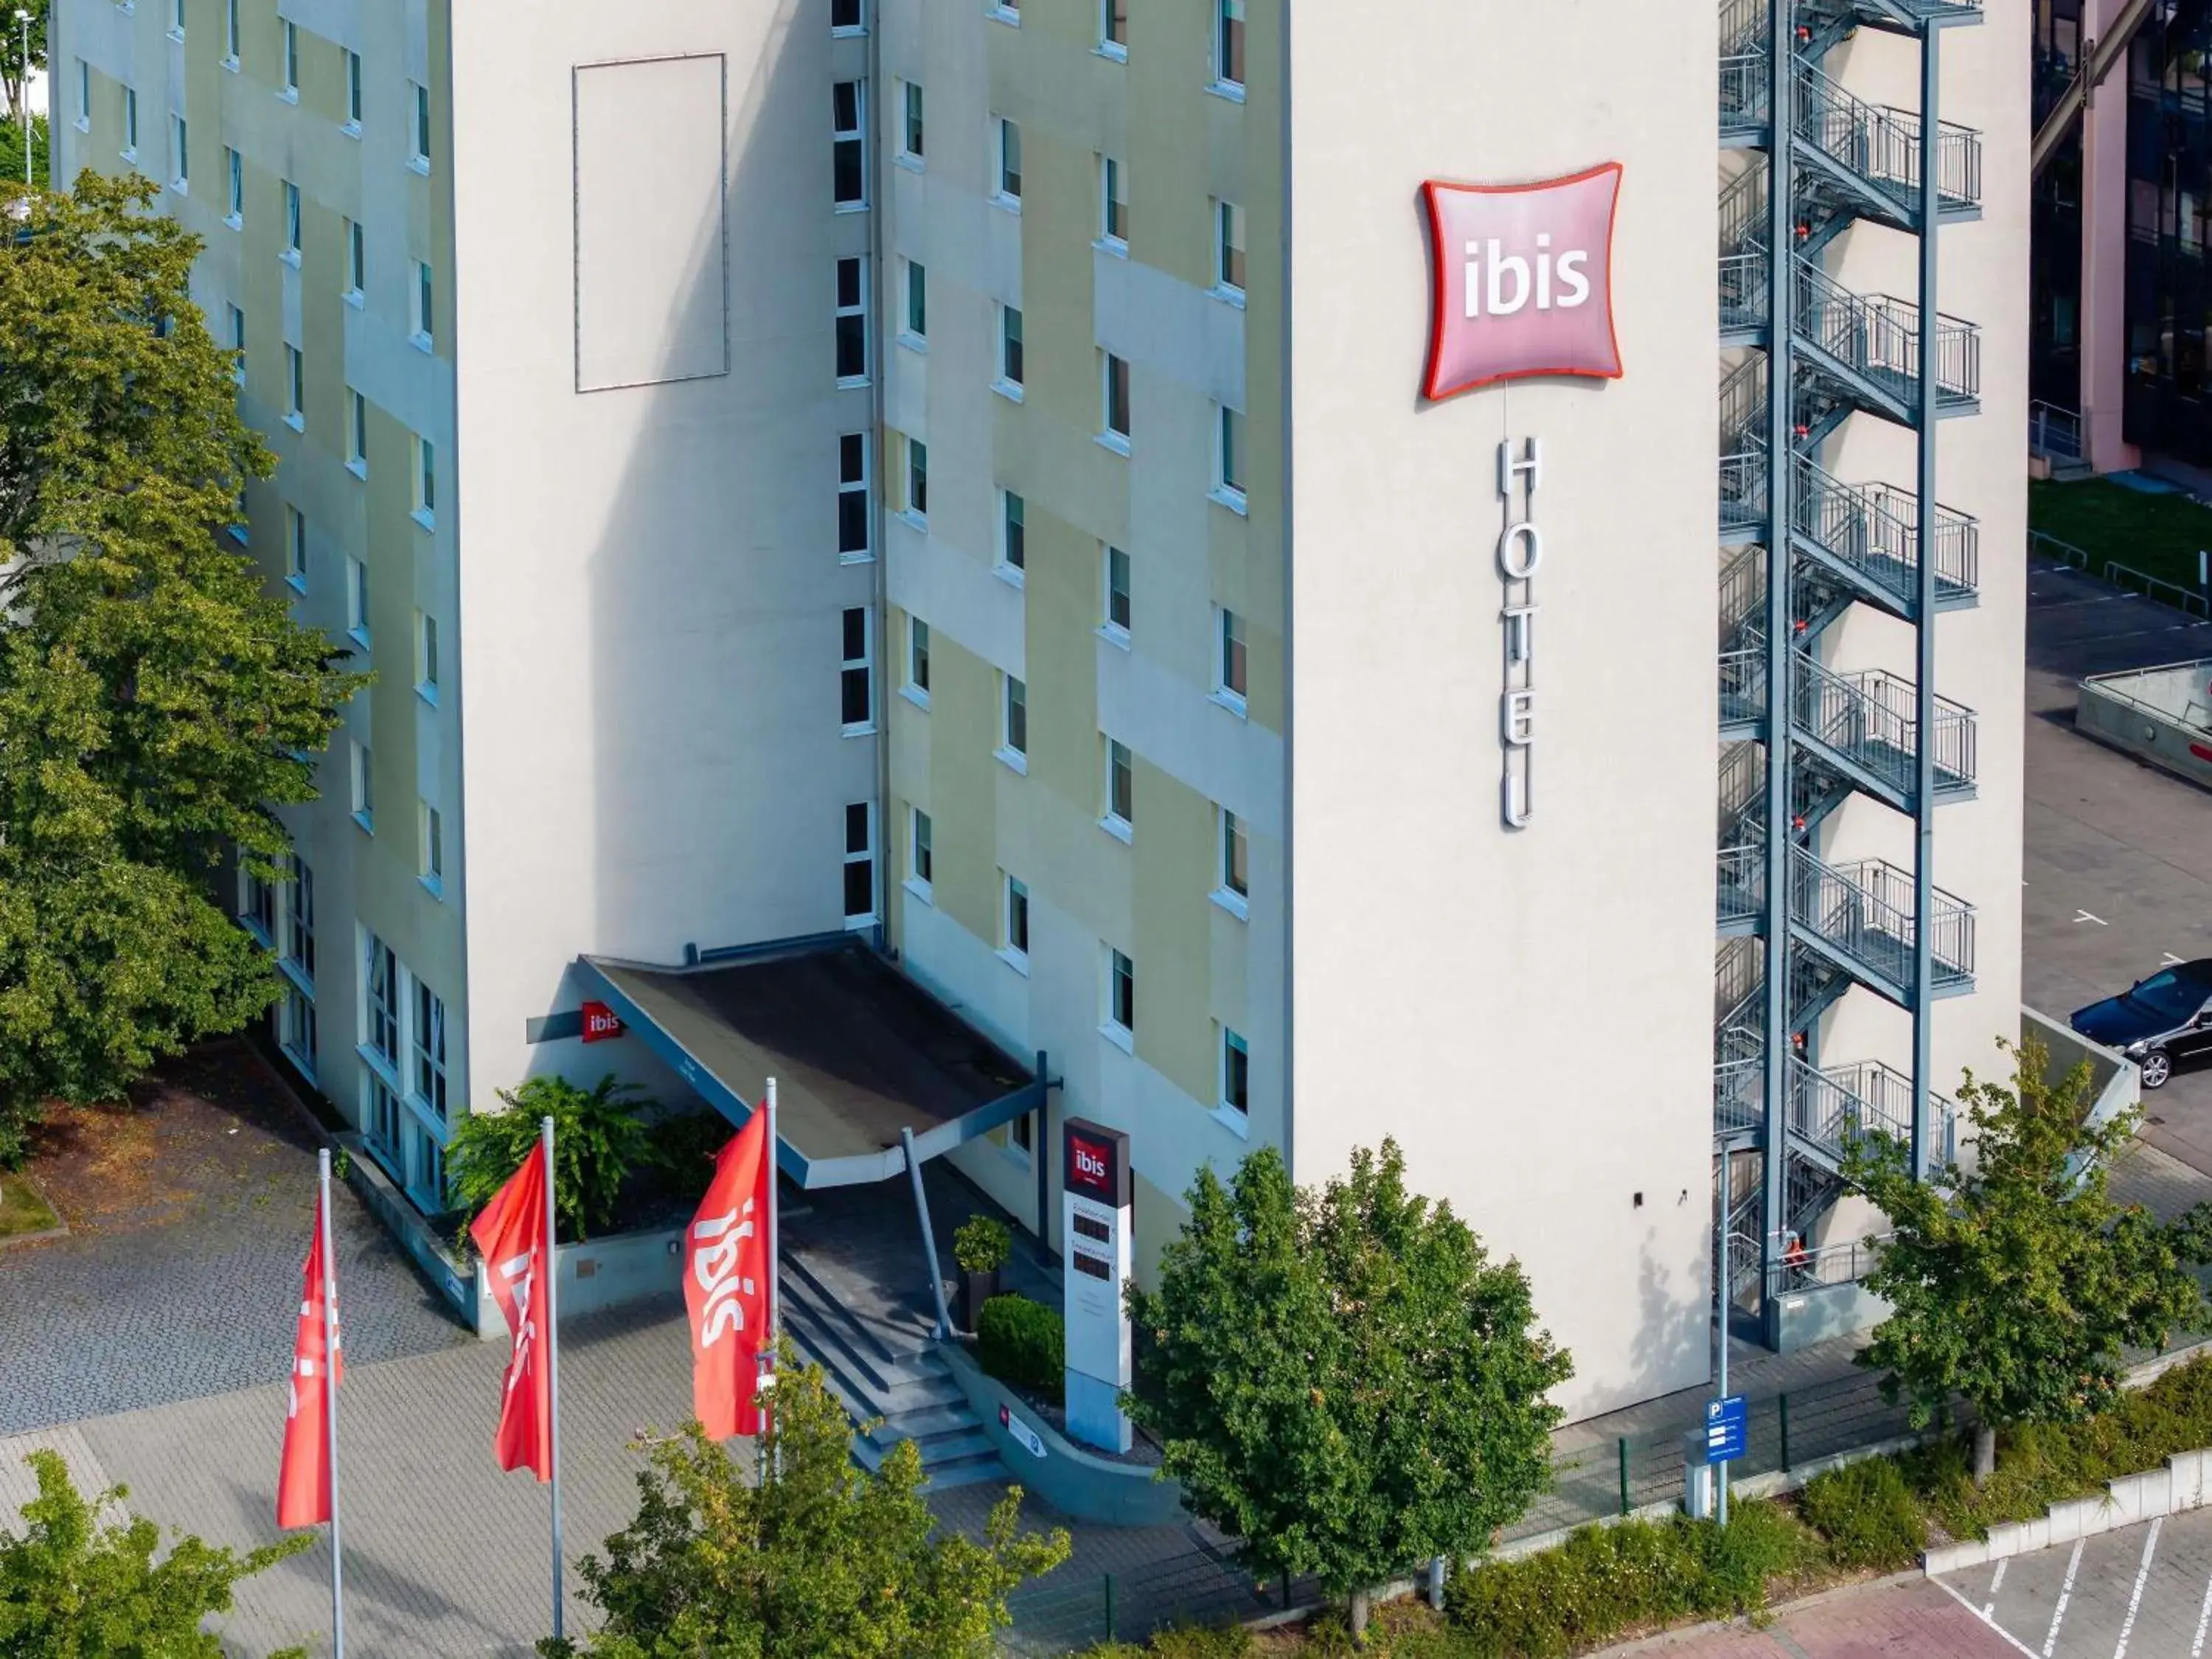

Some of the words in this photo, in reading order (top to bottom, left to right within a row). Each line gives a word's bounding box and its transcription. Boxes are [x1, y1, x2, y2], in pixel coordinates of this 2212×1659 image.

[1465, 233, 1590, 318] ibis
[1500, 437, 1543, 827] HOTEL
[591, 1013, 619, 1031] ibis
[1076, 1150, 1105, 1178] ibis
[694, 1197, 754, 1349] ibis
[1711, 1402, 1720, 1416] P
